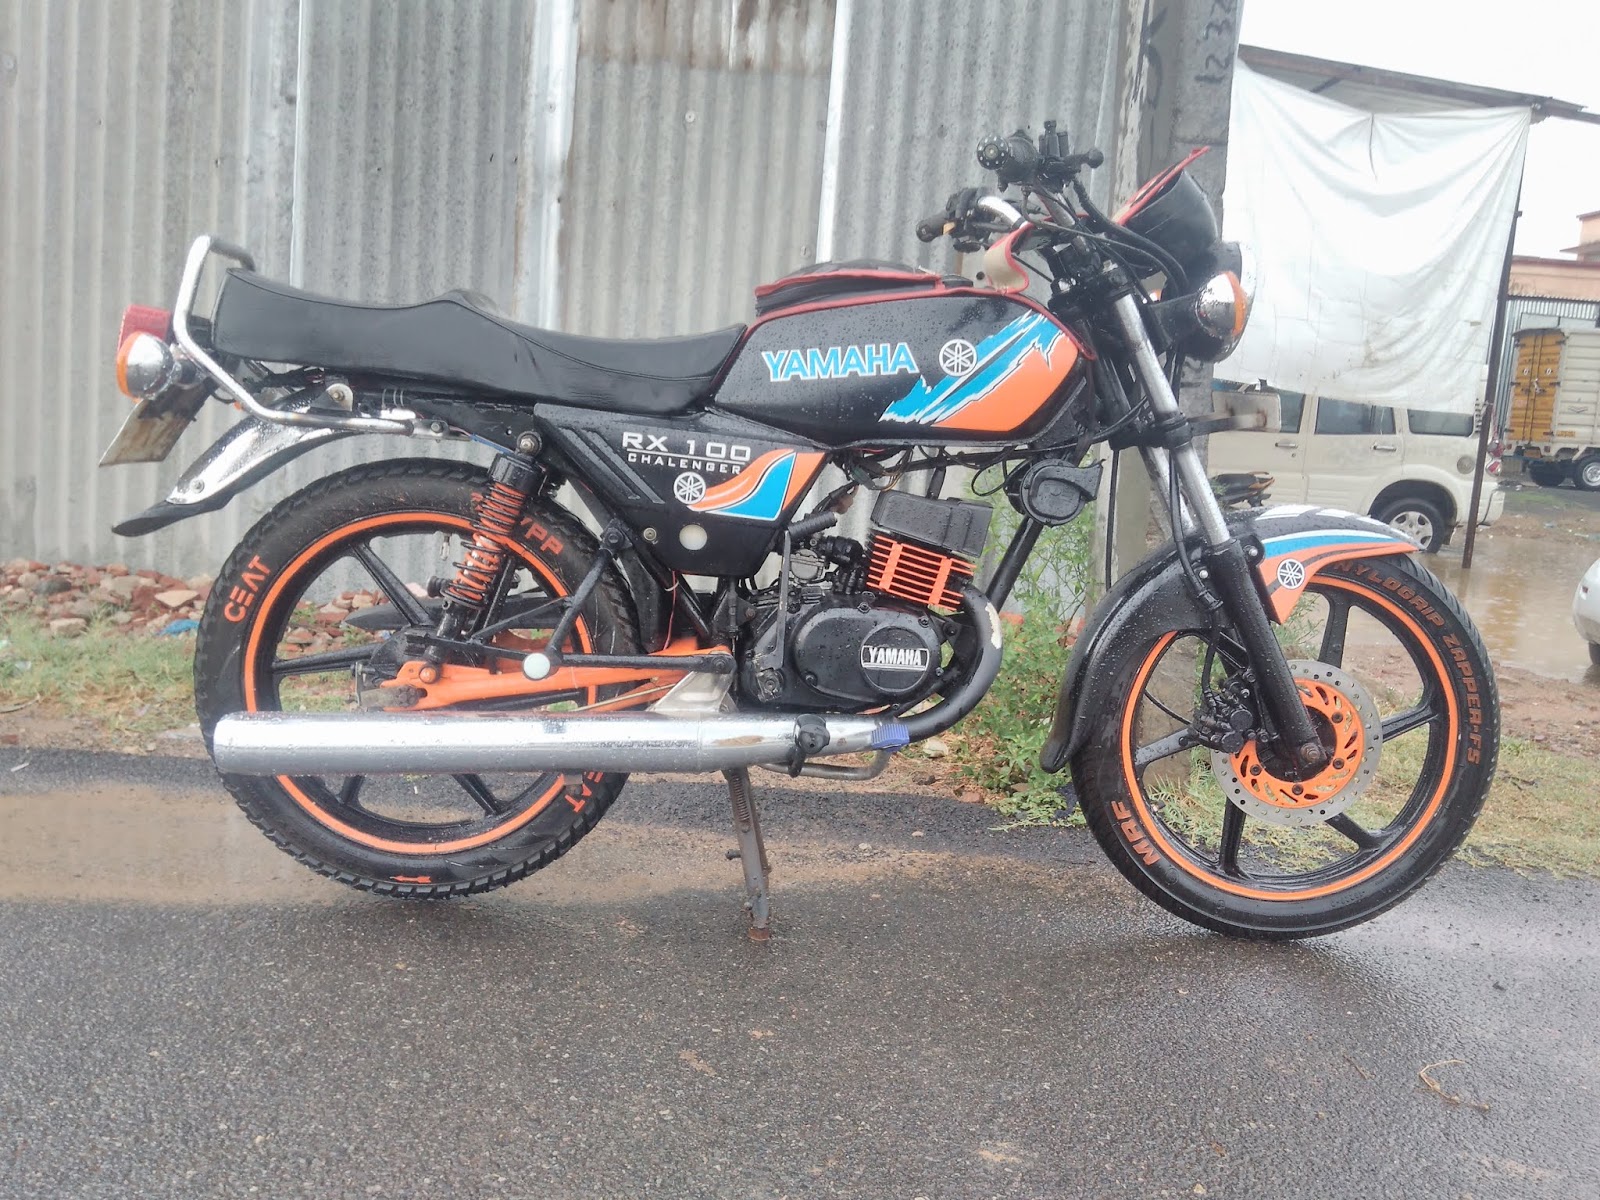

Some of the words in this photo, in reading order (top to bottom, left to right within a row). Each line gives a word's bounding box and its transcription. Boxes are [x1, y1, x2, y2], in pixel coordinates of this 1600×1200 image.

[761, 342, 919, 383] YAMAHA
[622, 431, 669, 453] RX
[686, 439, 752, 462] 100
[627, 452, 742, 475] CHALENGER
[223, 555, 271, 622] CEAT
[1333, 561, 1446, 627] NYLOGRIP
[867, 646, 922, 666] YAMAHA
[1110, 800, 1162, 866] MRF
